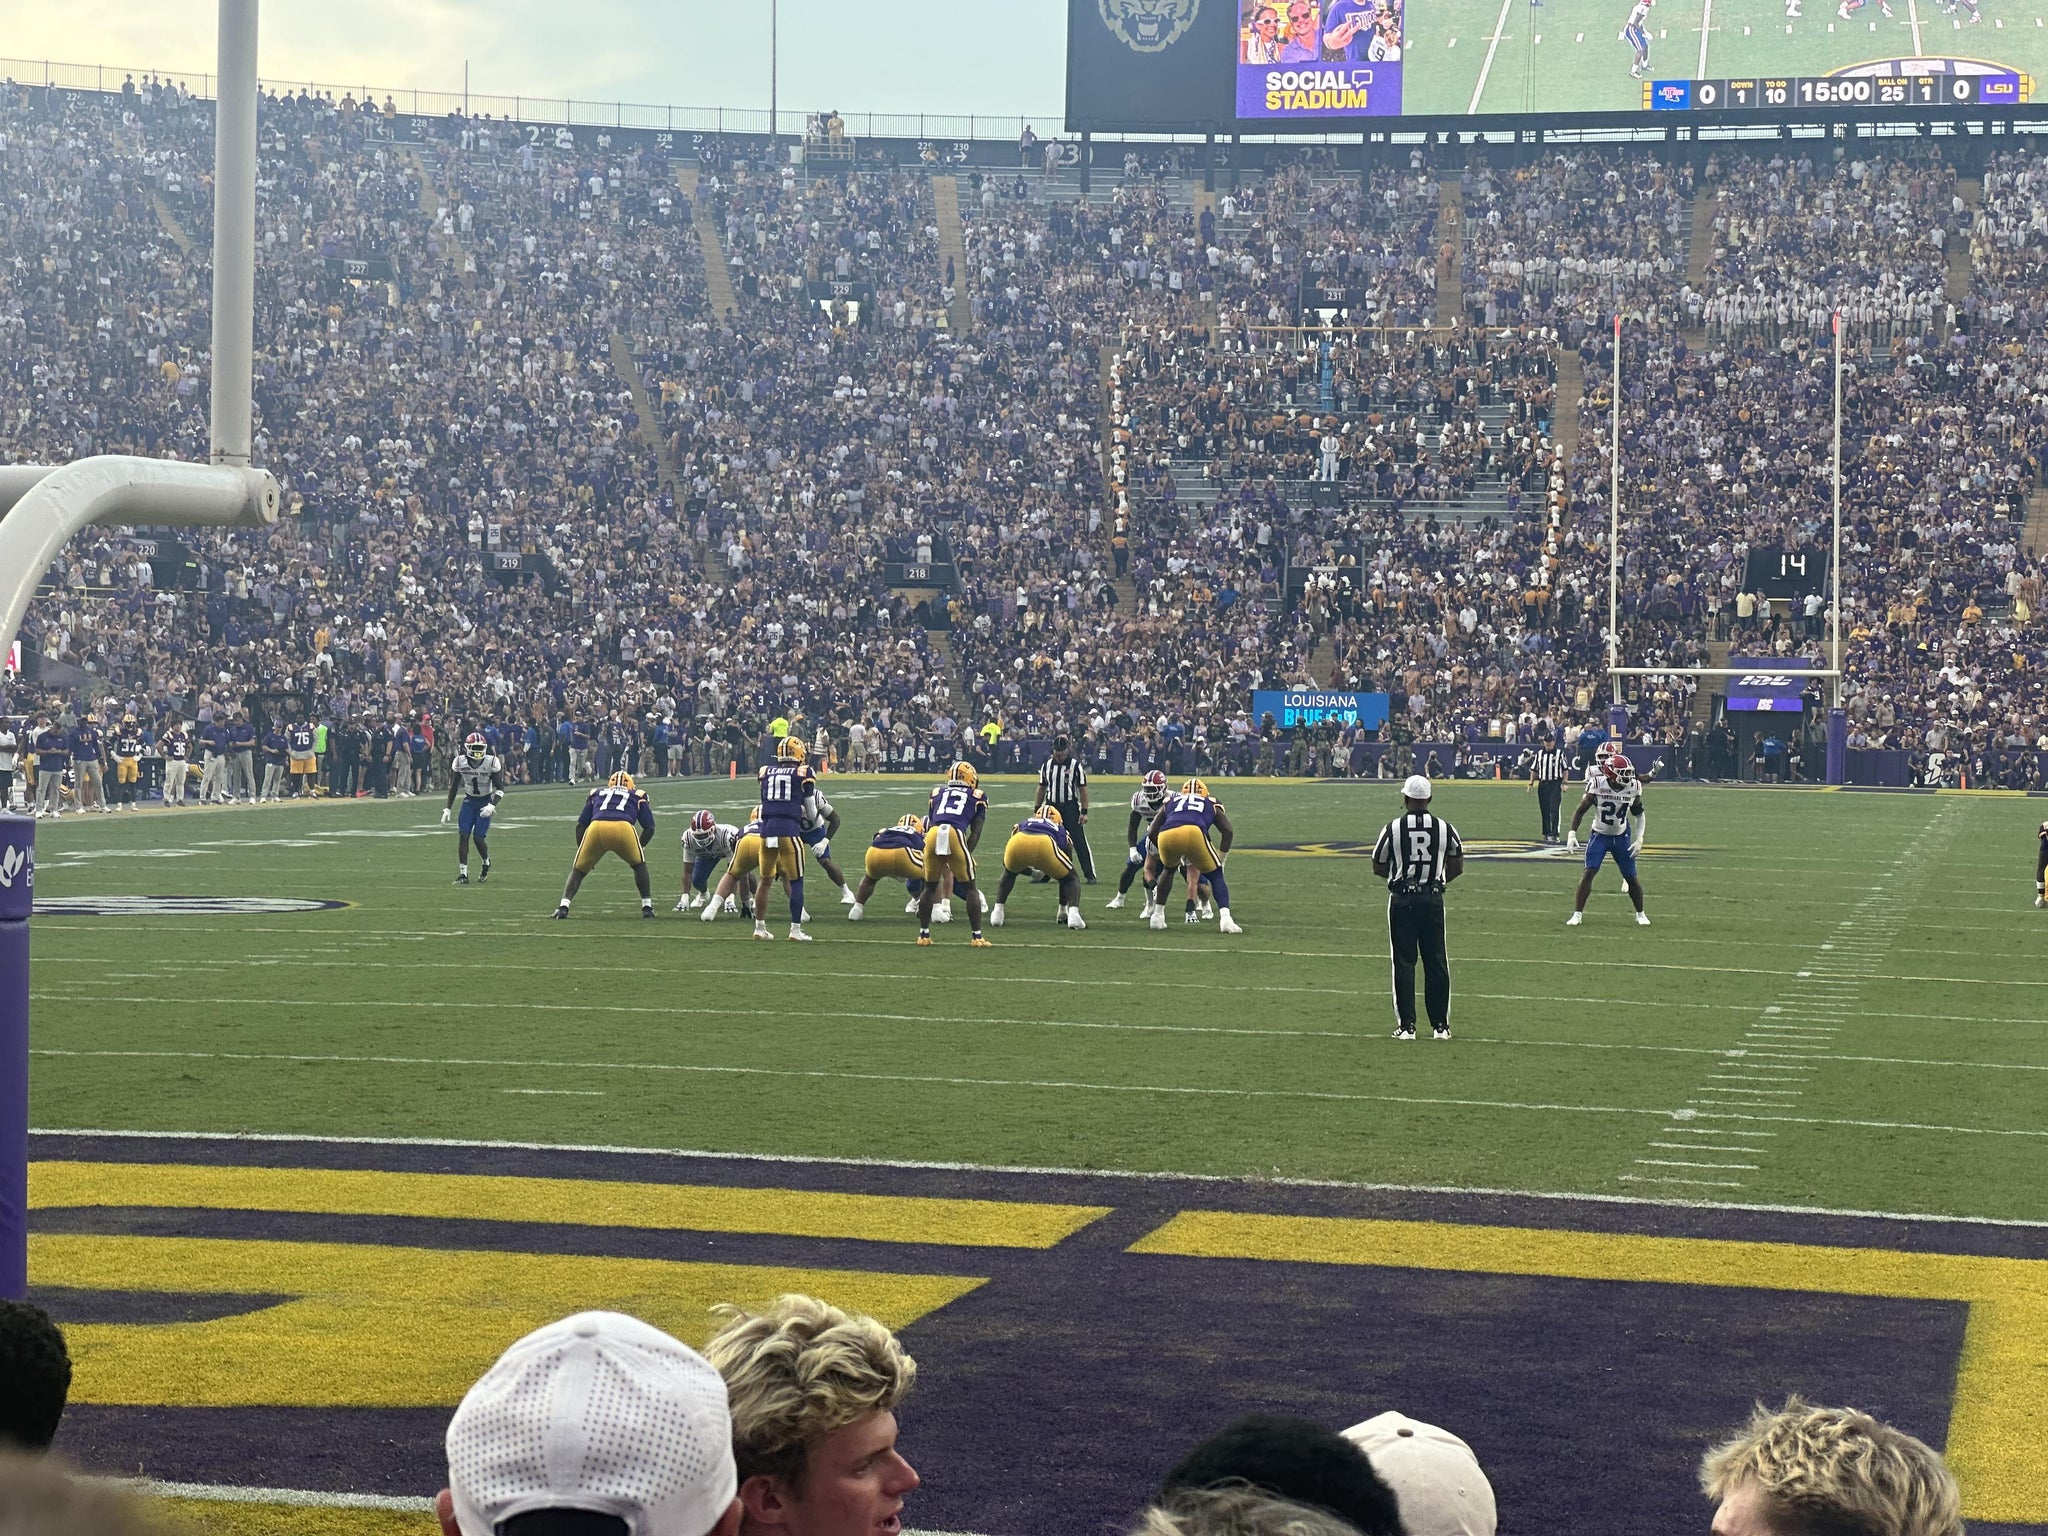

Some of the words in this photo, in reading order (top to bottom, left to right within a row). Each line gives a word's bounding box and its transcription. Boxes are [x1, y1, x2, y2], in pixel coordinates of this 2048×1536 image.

[1266, 71, 1351, 90] SOCIAL
[1731, 81, 1753, 89] DOWN
[1877, 78, 1896, 86] BALL
[1897, 78, 1908, 86] ON
[1918, 78, 1934, 86] QTR
[1700, 85, 1716, 104] 0
[1801, 81, 1870, 102] 15:00
[1880, 87, 1904, 101] 25
[1921, 87, 1930, 101] 1
[1953, 80, 1969, 99] 0
[1985, 82, 2013, 94] LSU
[1266, 90, 1367, 110] STADIUM
[1737, 90, 1746, 103] 1
[1767, 89, 1786, 103] 10
[411, 118, 427, 127] 228
[656, 133, 673, 142] 228
[953, 142, 969, 151] 230
[350, 265, 366, 274] 227
[833, 286, 850, 294] 229
[1328, 292, 1342, 301] 231
[139, 545, 155, 556] 220
[502, 559, 518, 568] 219
[1781, 554, 1806, 576] 14
[909, 569, 925, 578] 218
[1284, 695, 1358, 708] LOUISIANA
[1284, 708, 1323, 726] BLUE
[294, 732, 310, 745] 76
[121, 739, 137, 752] 37
[173, 742, 186, 756] 36
[766, 767, 796, 775] LEAVITT
[471, 777, 480, 795] 1
[766, 775, 792, 801] 10
[599, 789, 630, 811] 77
[936, 791, 967, 815] 13
[1174, 795, 1205, 813] 75
[1601, 801, 1630, 826] 24
[1408, 831, 1433, 861] R
